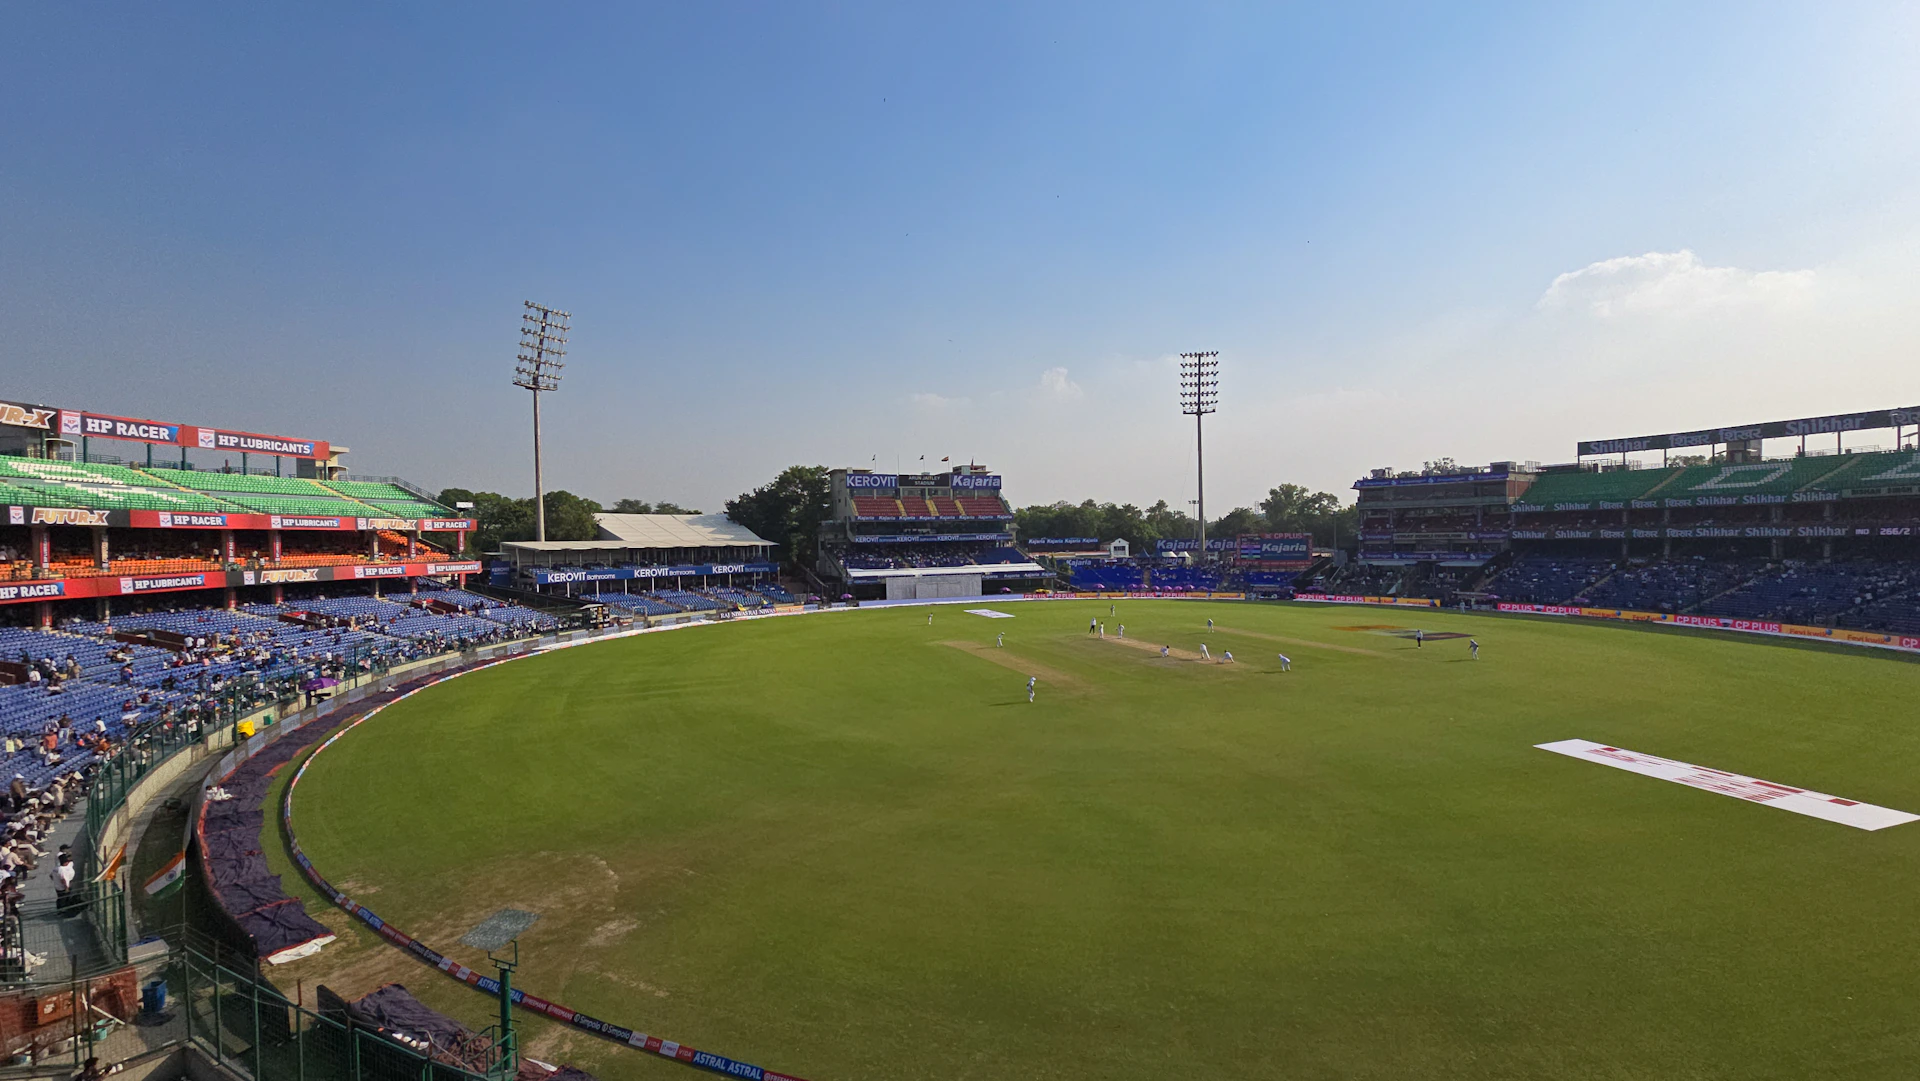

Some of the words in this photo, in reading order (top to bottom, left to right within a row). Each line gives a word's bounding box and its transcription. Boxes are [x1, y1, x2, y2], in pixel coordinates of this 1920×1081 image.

[86, 418, 113, 434] HP
[116, 422, 170, 440] RACER
[1786, 416, 1864, 436] Shikhar
[218, 434, 240, 447] HP
[240, 437, 311, 454] LUBRICANTS
[1590, 439, 1650, 454] Shikhar
[846, 475, 896, 487] KEROVIT
[952, 475, 1000, 489] Kajaria
[1696, 496, 1738, 506] Shikhar
[1742, 493, 1787, 504] Shikhar
[1792, 492, 1840, 503] Shikhar
[1510, 502, 1545, 513] Shikhar
[1554, 502, 1591, 511] Shikhar
[32, 508, 110, 526] FUTUR-X
[174, 515, 190, 525] HP
[191, 516, 223, 526] RACER
[294, 519, 338, 527] LUBRICANTS
[368, 519, 417, 529] FUTUR-X
[446, 521, 468, 529] RACER
[1512, 530, 1547, 539] Shikhar
[1555, 530, 1592, 539] Shikhar
[1695, 527, 1741, 538] Shikhar
[1745, 527, 1792, 537] Shikhar
[1797, 526, 1848, 537] Shikhar
[1880, 527, 1911, 536] 266/2
[1157, 540, 1200, 551] Kajaria
[1262, 543, 1307, 553] Kajaria
[365, 568, 376, 576] HP
[376, 567, 402, 575] RACER
[445, 564, 478, 572] LUBRICANTS
[634, 568, 669, 578] KEROVIT
[712, 564, 745, 574] KEROVIT
[260, 569, 318, 584] FUTUR-X
[547, 572, 586, 583] KEROVIT
[135, 580, 149, 589] HP
[150, 577, 202, 589] LUBRICANTS
[0, 587, 18, 598] HP
[20, 584, 58, 598] RACER
[1677, 616, 1689, 624] CP
[1691, 617, 1717, 626] PLUS
[1736, 621, 1750, 630] CP
[1752, 623, 1779, 632] PLUS
[1902, 638, 1917, 648] CP
[476, 978, 500, 992] ASTRAL
[580, 1016, 601, 1030] Simpolo
[608, 1025, 630, 1039] Simpolo
[678, 1049, 691, 1057] VIDA
[693, 1053, 726, 1070] ASTRAL
[727, 1062, 761, 1079] ASTRAL
